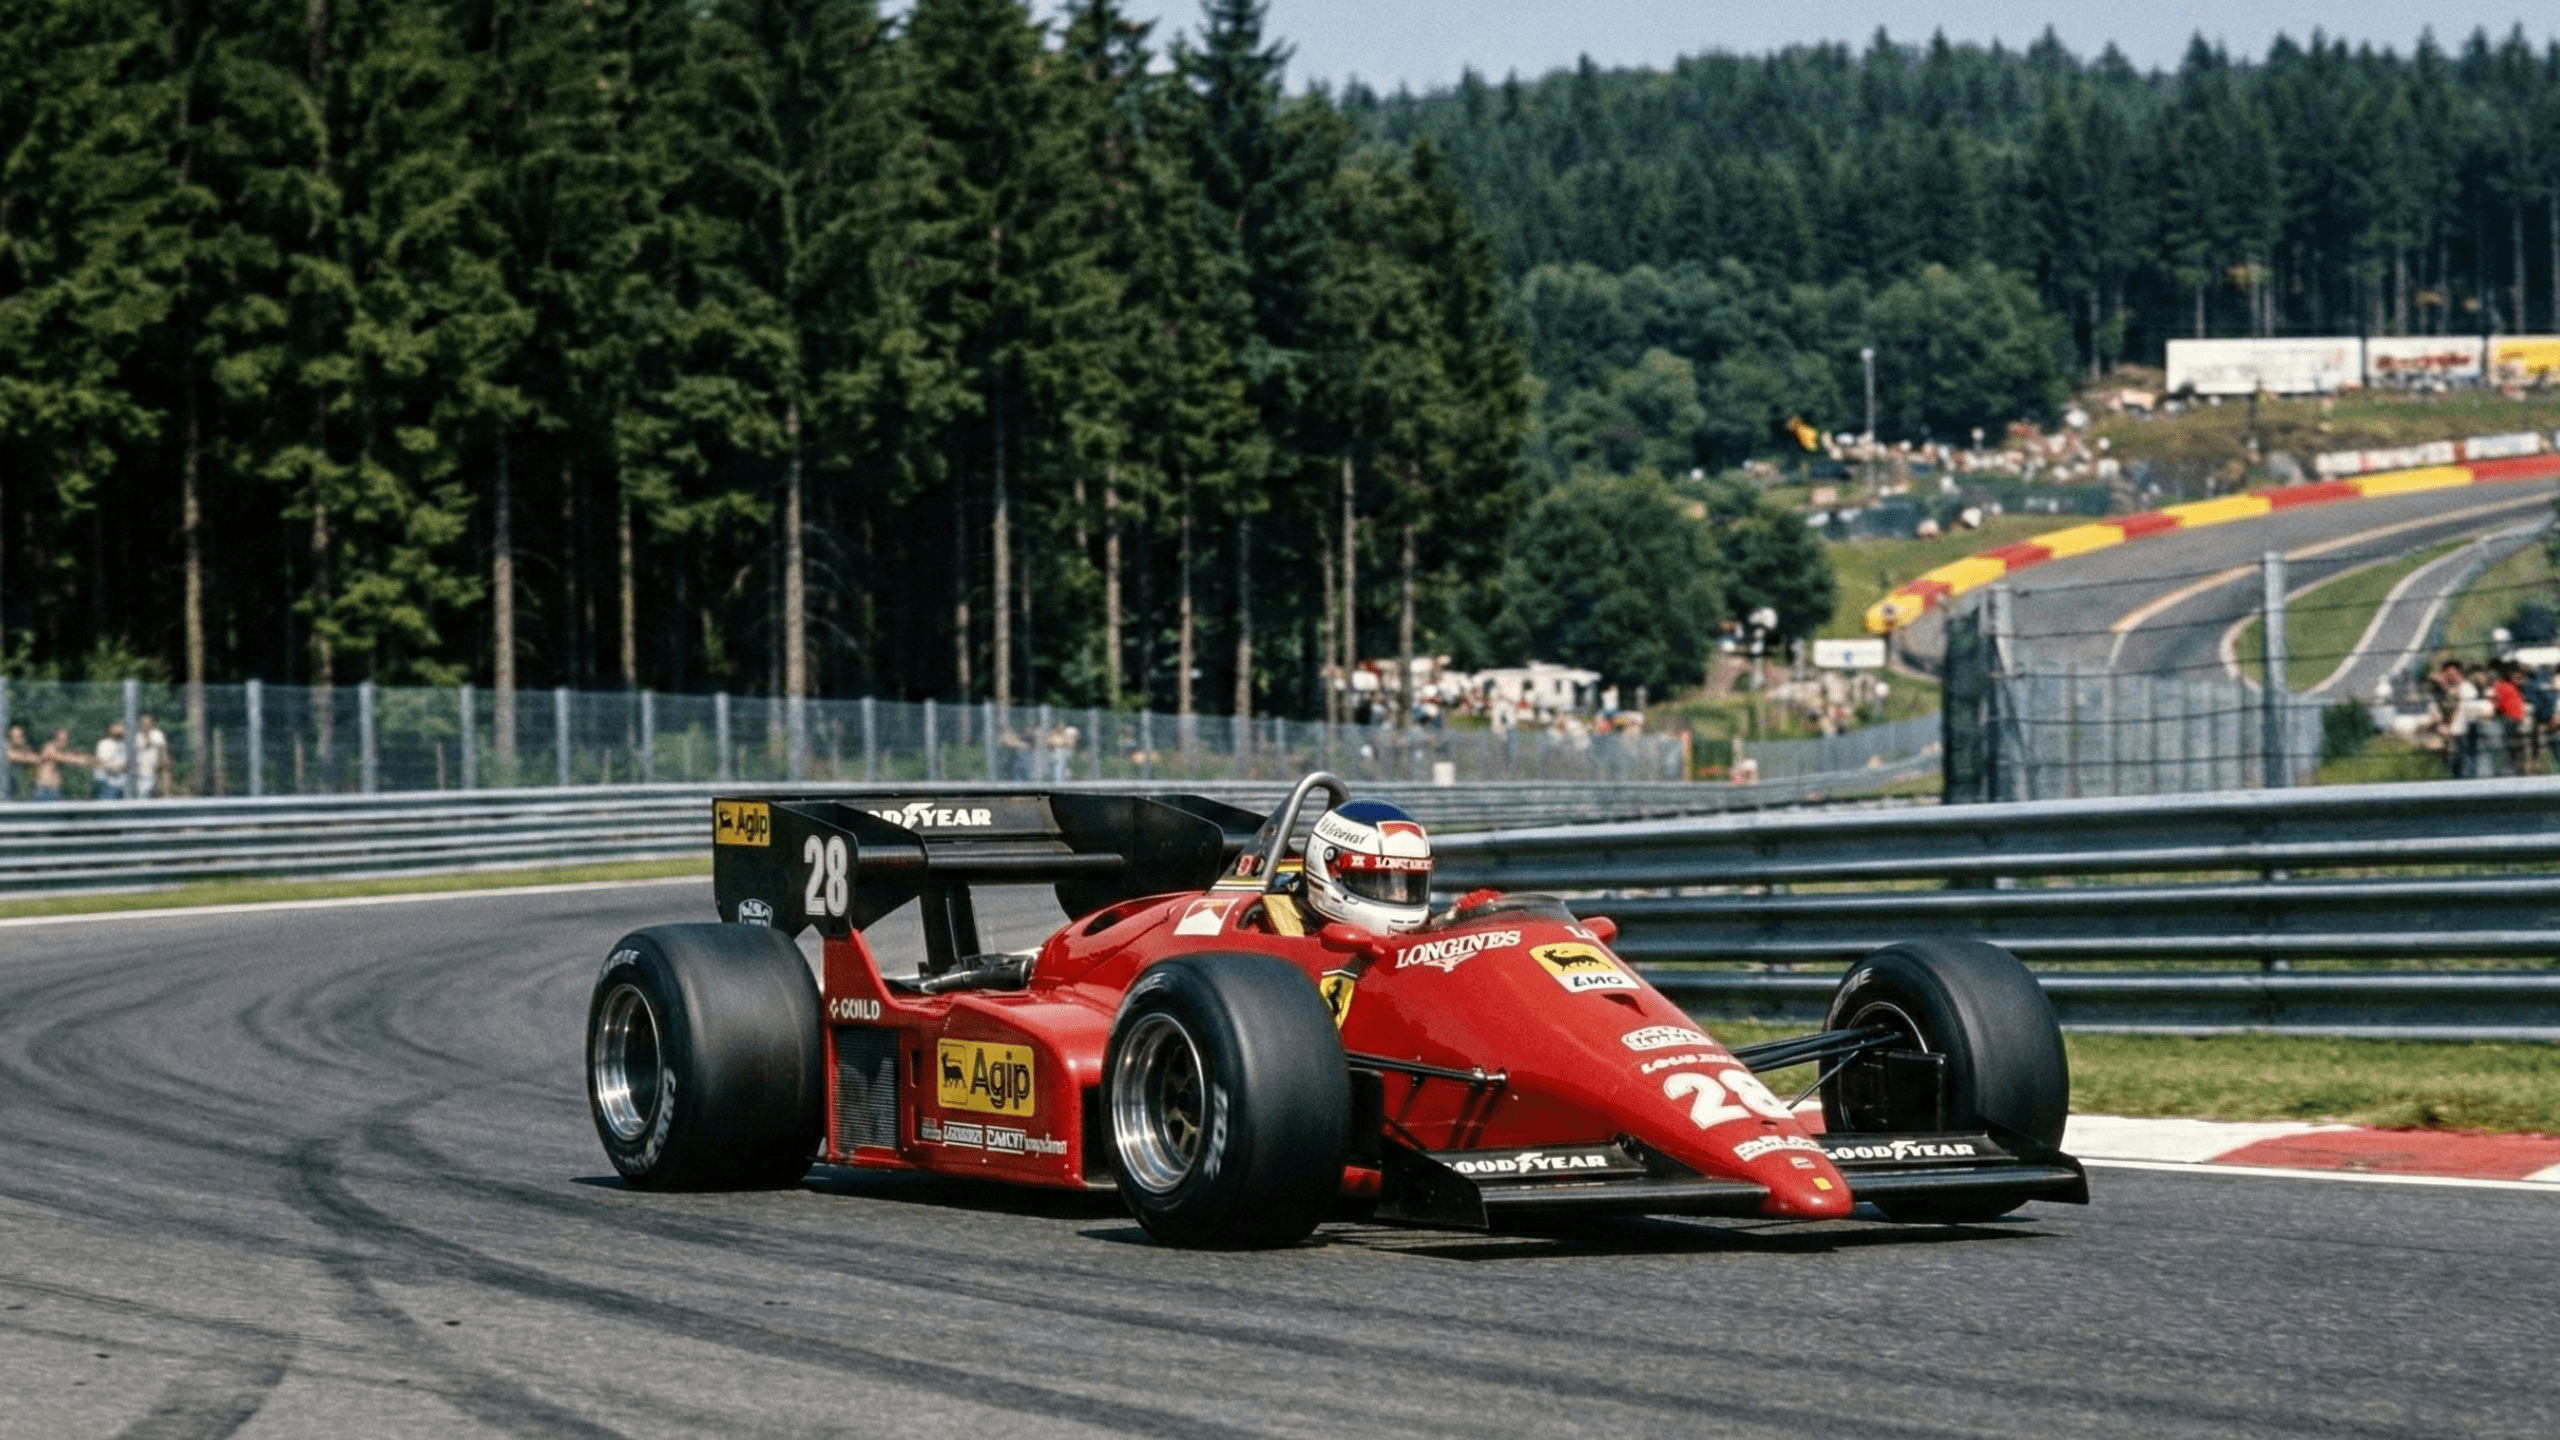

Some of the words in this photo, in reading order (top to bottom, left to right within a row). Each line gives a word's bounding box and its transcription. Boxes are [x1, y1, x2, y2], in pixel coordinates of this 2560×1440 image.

[735, 806, 767, 842] Agip
[804, 834, 848, 917] 28
[1395, 930, 1521, 968] LONGINES
[970, 1047, 1031, 1110] Agip
[1663, 1069, 1796, 1130] 28
[1443, 1152, 1608, 1174] OODYEAR
